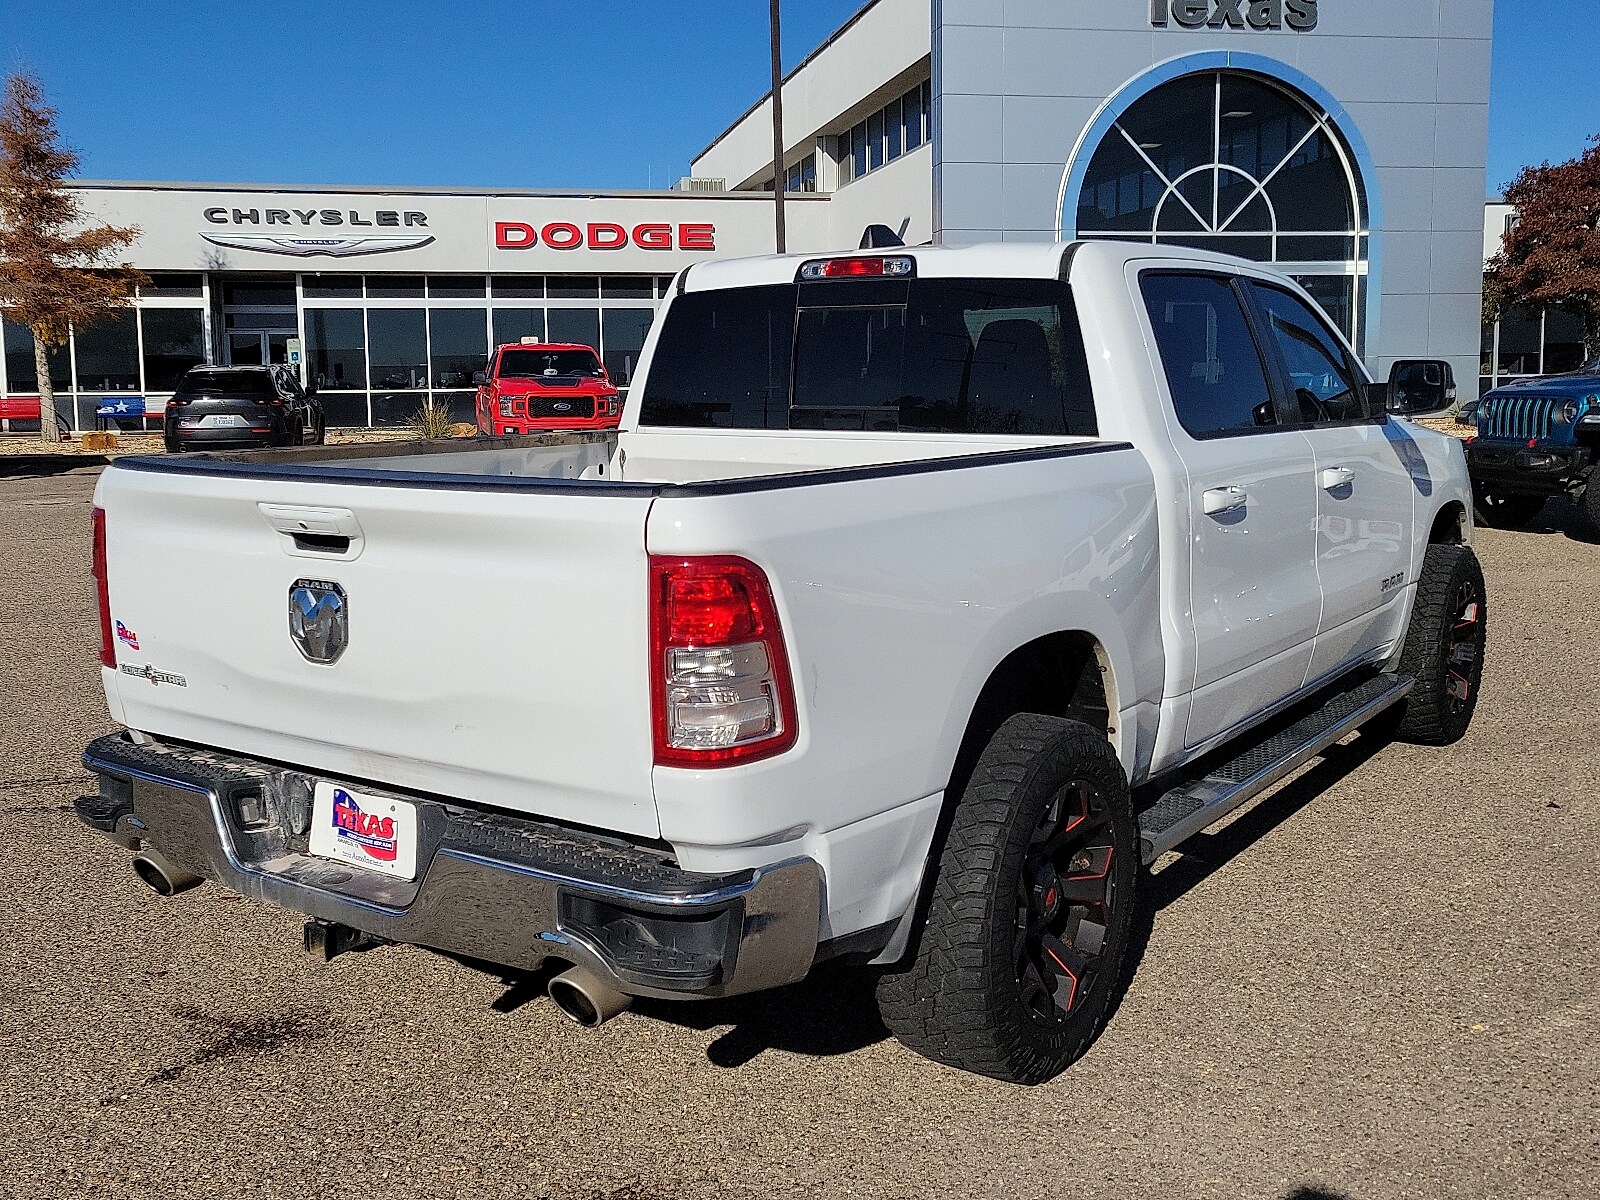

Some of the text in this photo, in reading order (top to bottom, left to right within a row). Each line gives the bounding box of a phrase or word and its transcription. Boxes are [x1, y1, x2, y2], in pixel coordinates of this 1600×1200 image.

[203, 207, 429, 227] CHRYSLER
[495, 222, 716, 251] DODGE
[298, 580, 334, 590] RAM
[153, 669, 187, 688] STAR
[335, 803, 394, 839] TEXAS
